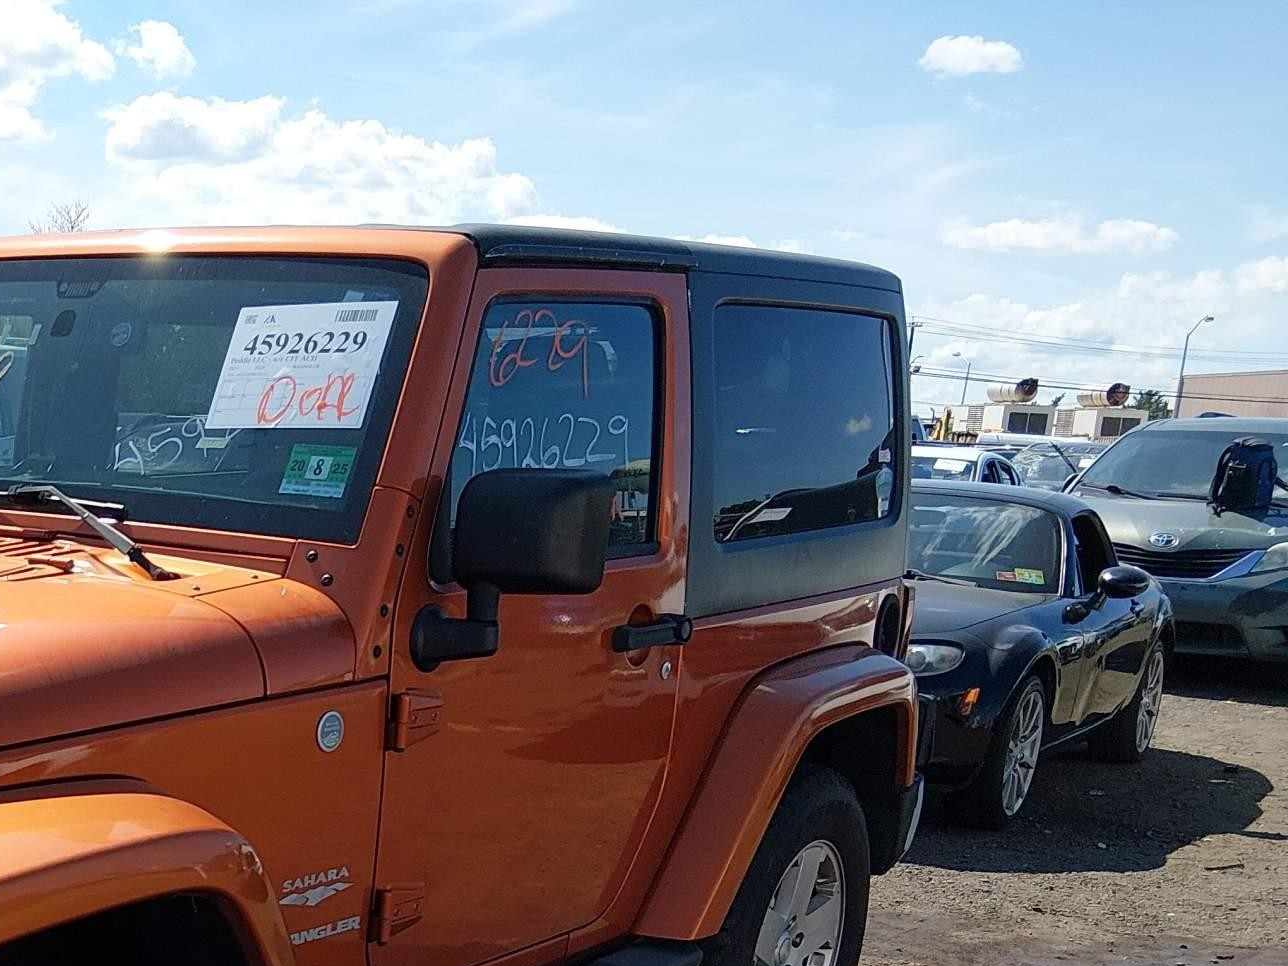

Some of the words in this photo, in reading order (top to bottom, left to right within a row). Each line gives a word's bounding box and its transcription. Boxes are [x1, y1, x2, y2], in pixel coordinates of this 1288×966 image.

[244, 331, 368, 356] 45926229
[112, 416, 230, 476] 459
[459, 411, 630, 478] 45926229
[290, 459, 306, 472] 20
[313, 458, 325, 476] 8
[332, 462, 349, 475] 25
[281, 866, 350, 893] SAHARA
[290, 916, 361, 945] ANGLER
